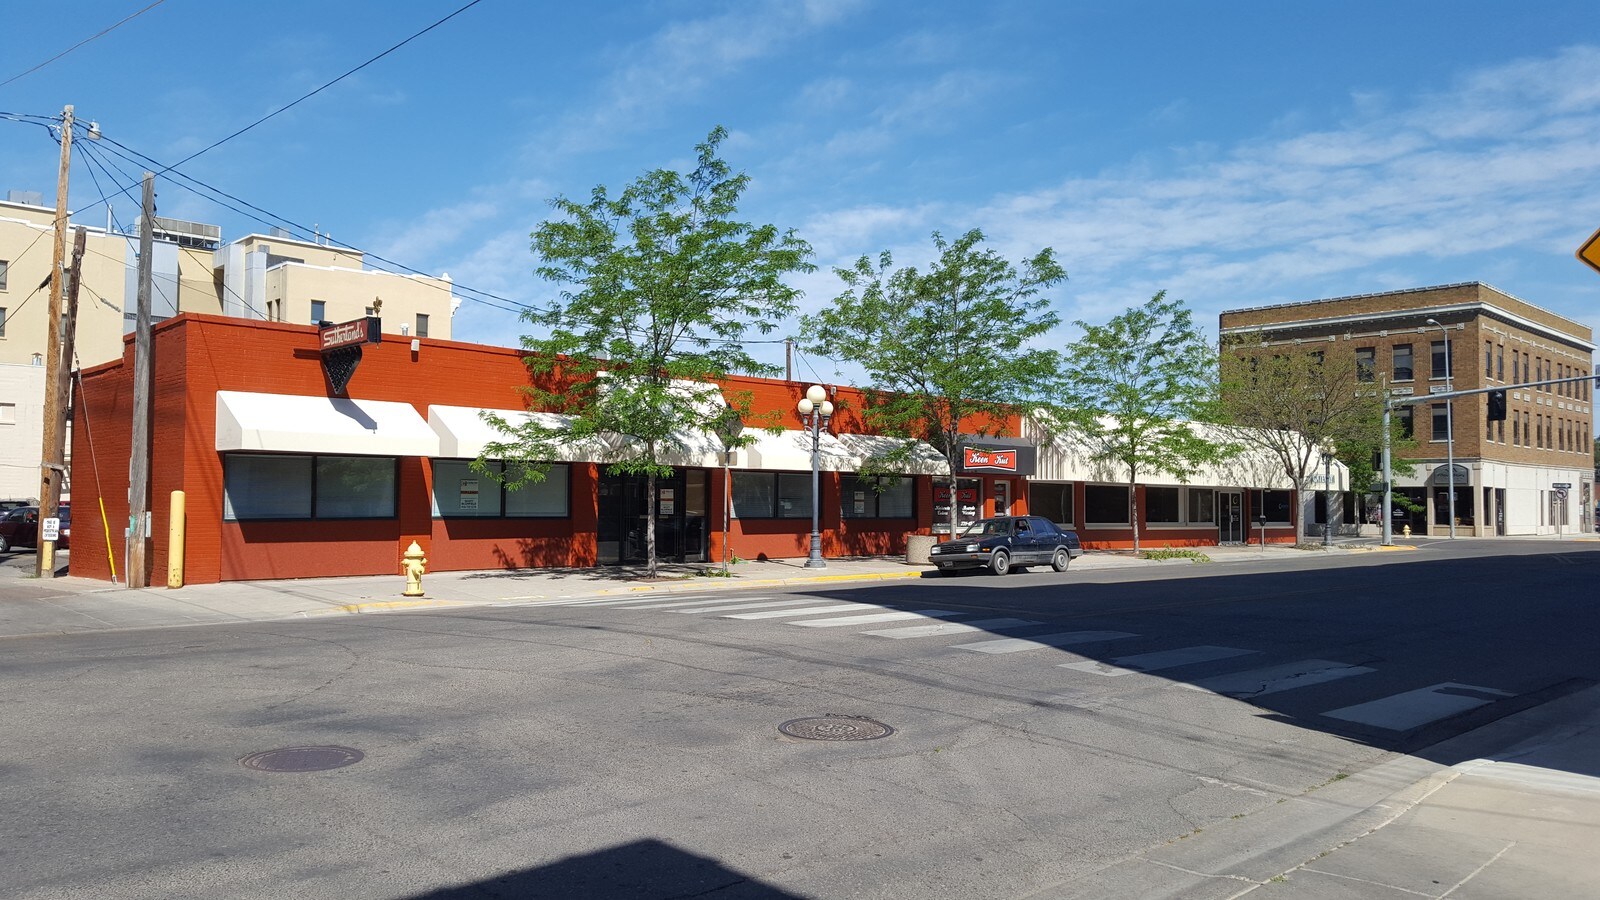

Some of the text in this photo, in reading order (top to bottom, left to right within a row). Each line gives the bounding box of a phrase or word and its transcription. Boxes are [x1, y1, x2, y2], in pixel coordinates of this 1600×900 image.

[323, 321, 364, 347] Sutherland's
[969, 452, 1009, 465] Keen Kut
